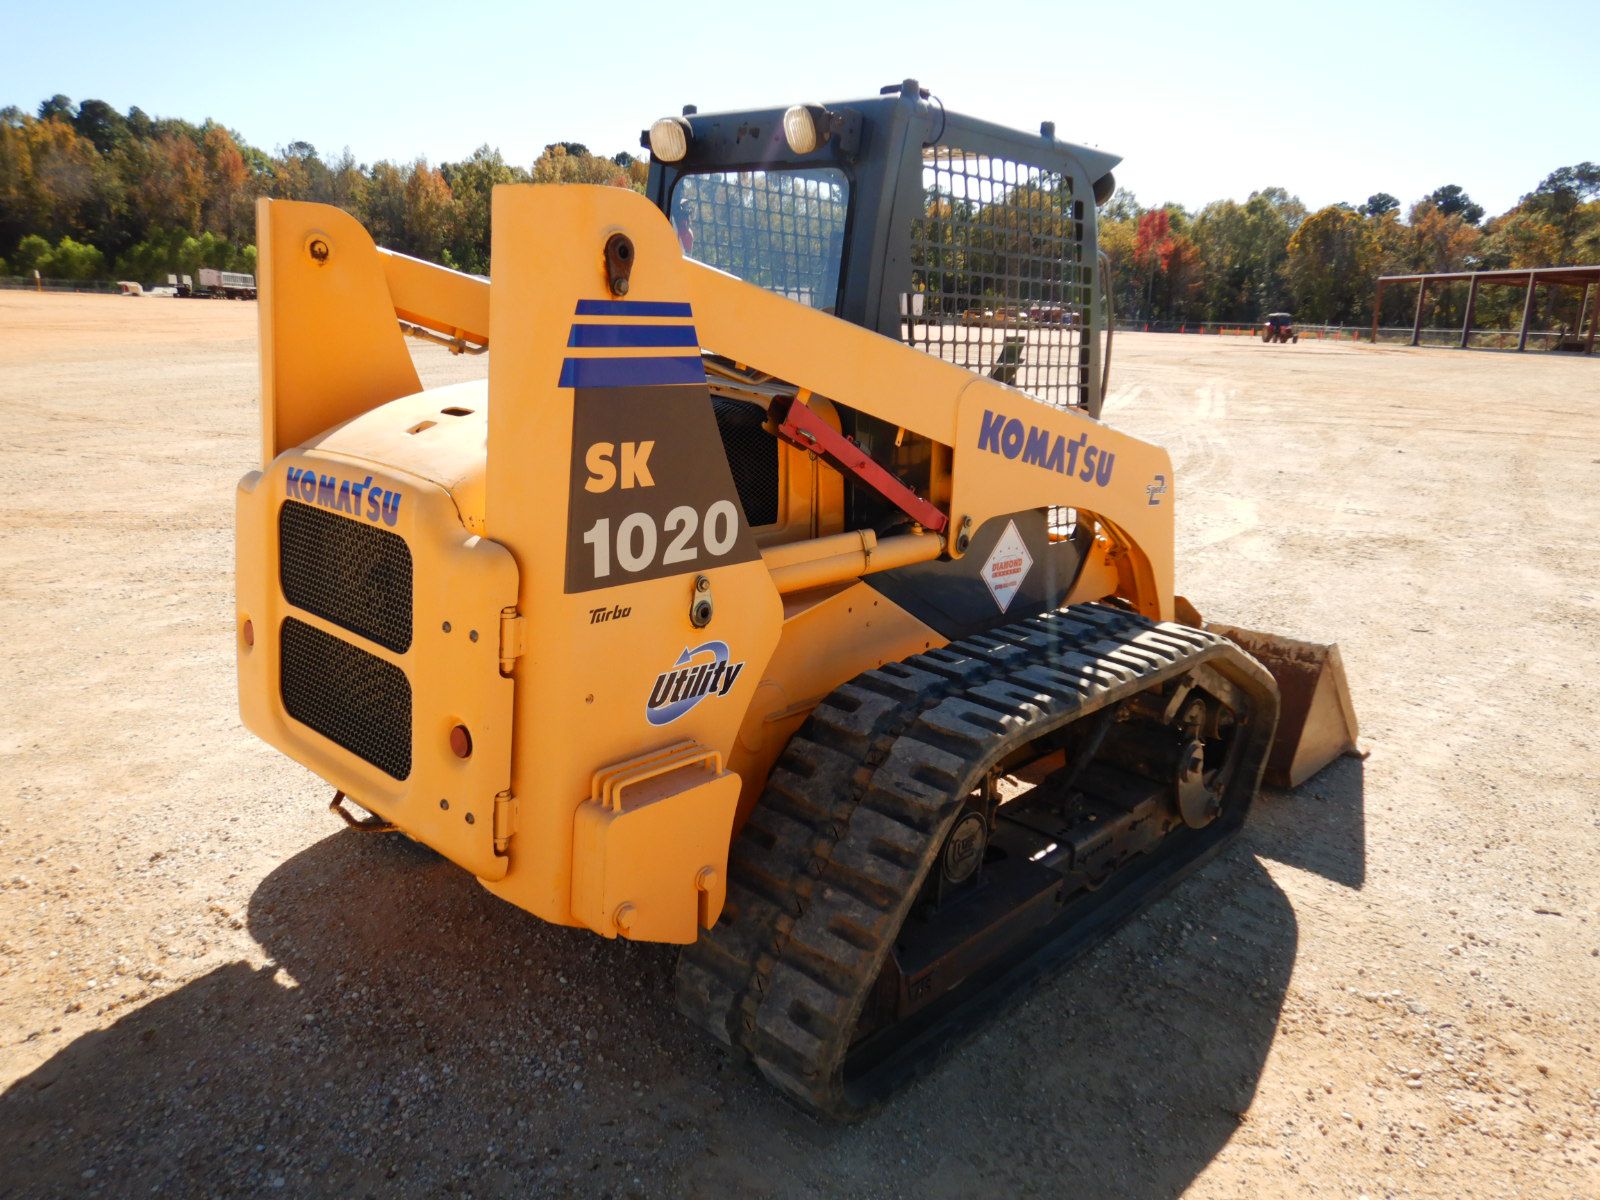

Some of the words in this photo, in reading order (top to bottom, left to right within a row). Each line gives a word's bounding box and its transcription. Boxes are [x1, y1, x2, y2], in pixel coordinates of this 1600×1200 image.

[584, 440, 656, 494] SK
[977, 409, 1115, 487] KOMATSU
[286, 466, 402, 527] KOMATSU
[583, 499, 739, 579] 1020
[589, 604, 632, 625] Turbo
[647, 659, 745, 709] Utility
